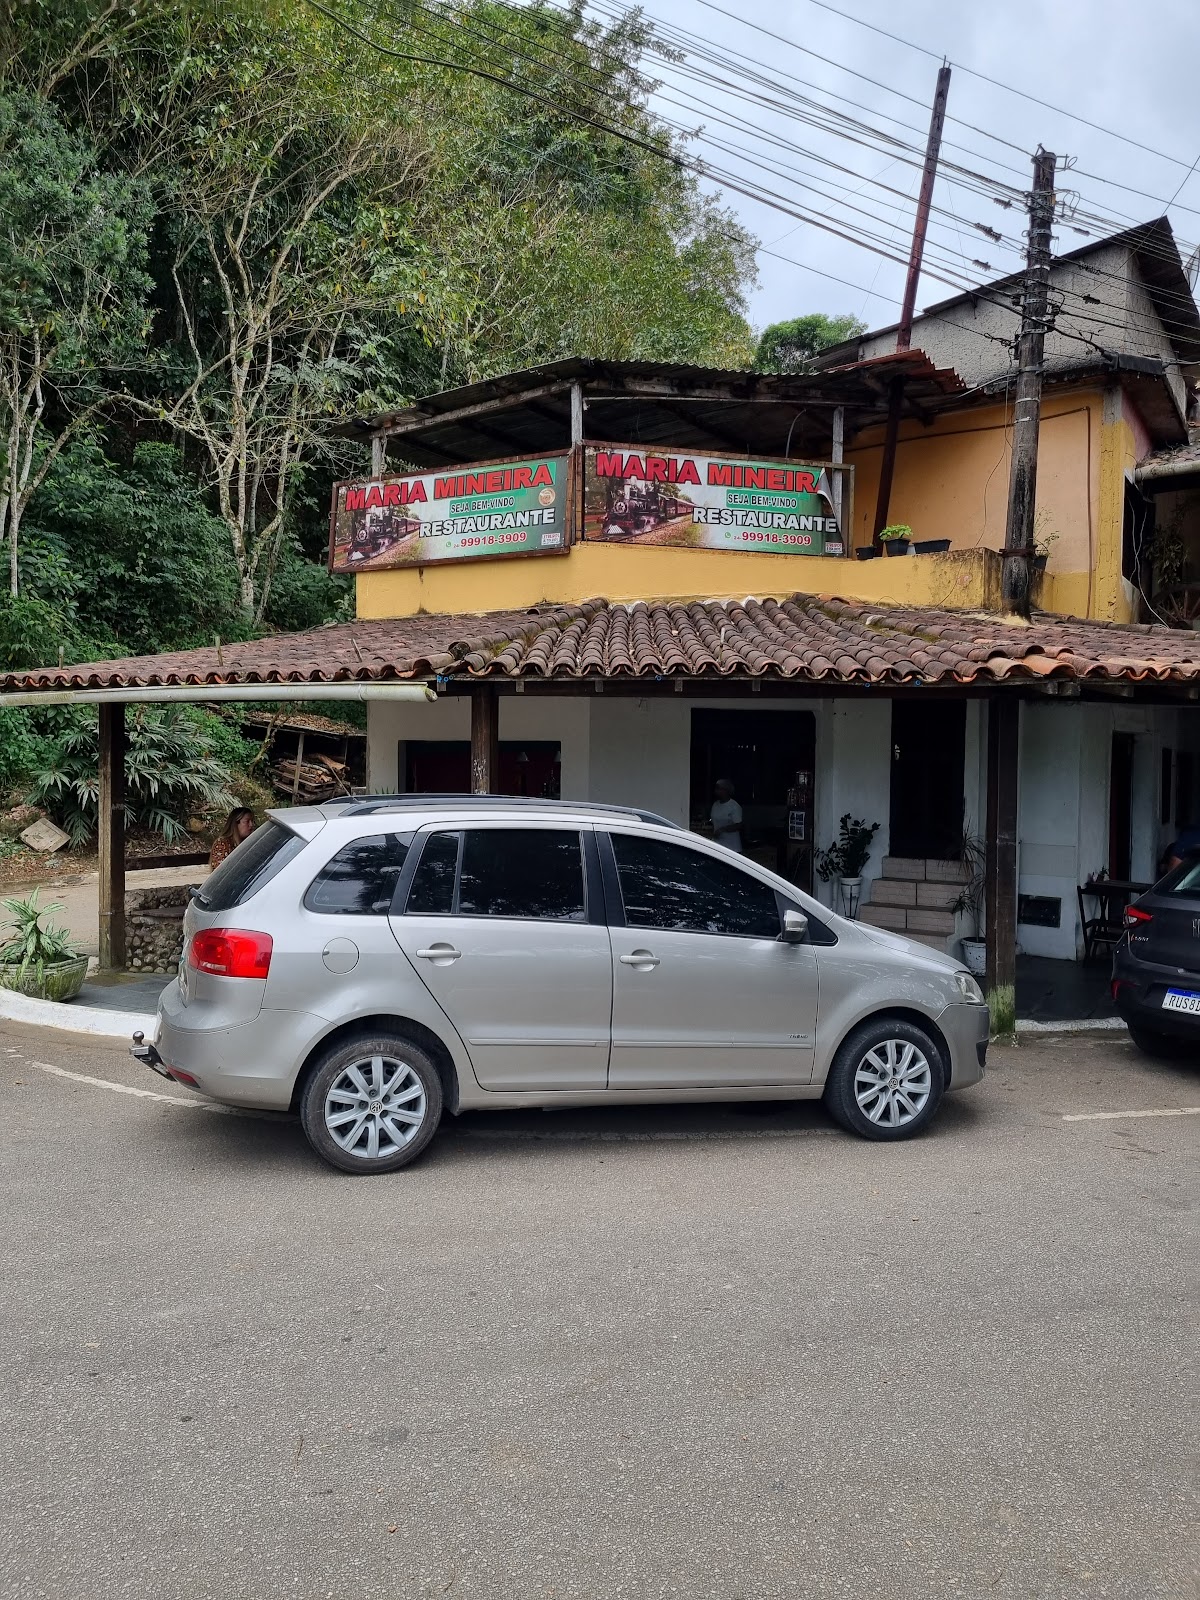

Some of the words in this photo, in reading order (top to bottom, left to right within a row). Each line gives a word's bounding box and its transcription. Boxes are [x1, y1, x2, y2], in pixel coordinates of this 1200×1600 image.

[596, 452, 701, 485] MARIA
[708, 463, 819, 493] MINEIR
[346, 480, 427, 511] MARIA
[434, 464, 553, 499] MINEIRA
[451, 502, 470, 514] SEJA
[472, 496, 515, 511] BEM-VINDO
[728, 493, 749, 505] SEJA
[751, 496, 797, 508] BEM-VINDO
[419, 508, 556, 538] RESTAURANTE
[692, 507, 837, 533] RESTAURANTE
[460, 532, 527, 548] 99918-3909
[742, 531, 812, 546] 99918-3909
